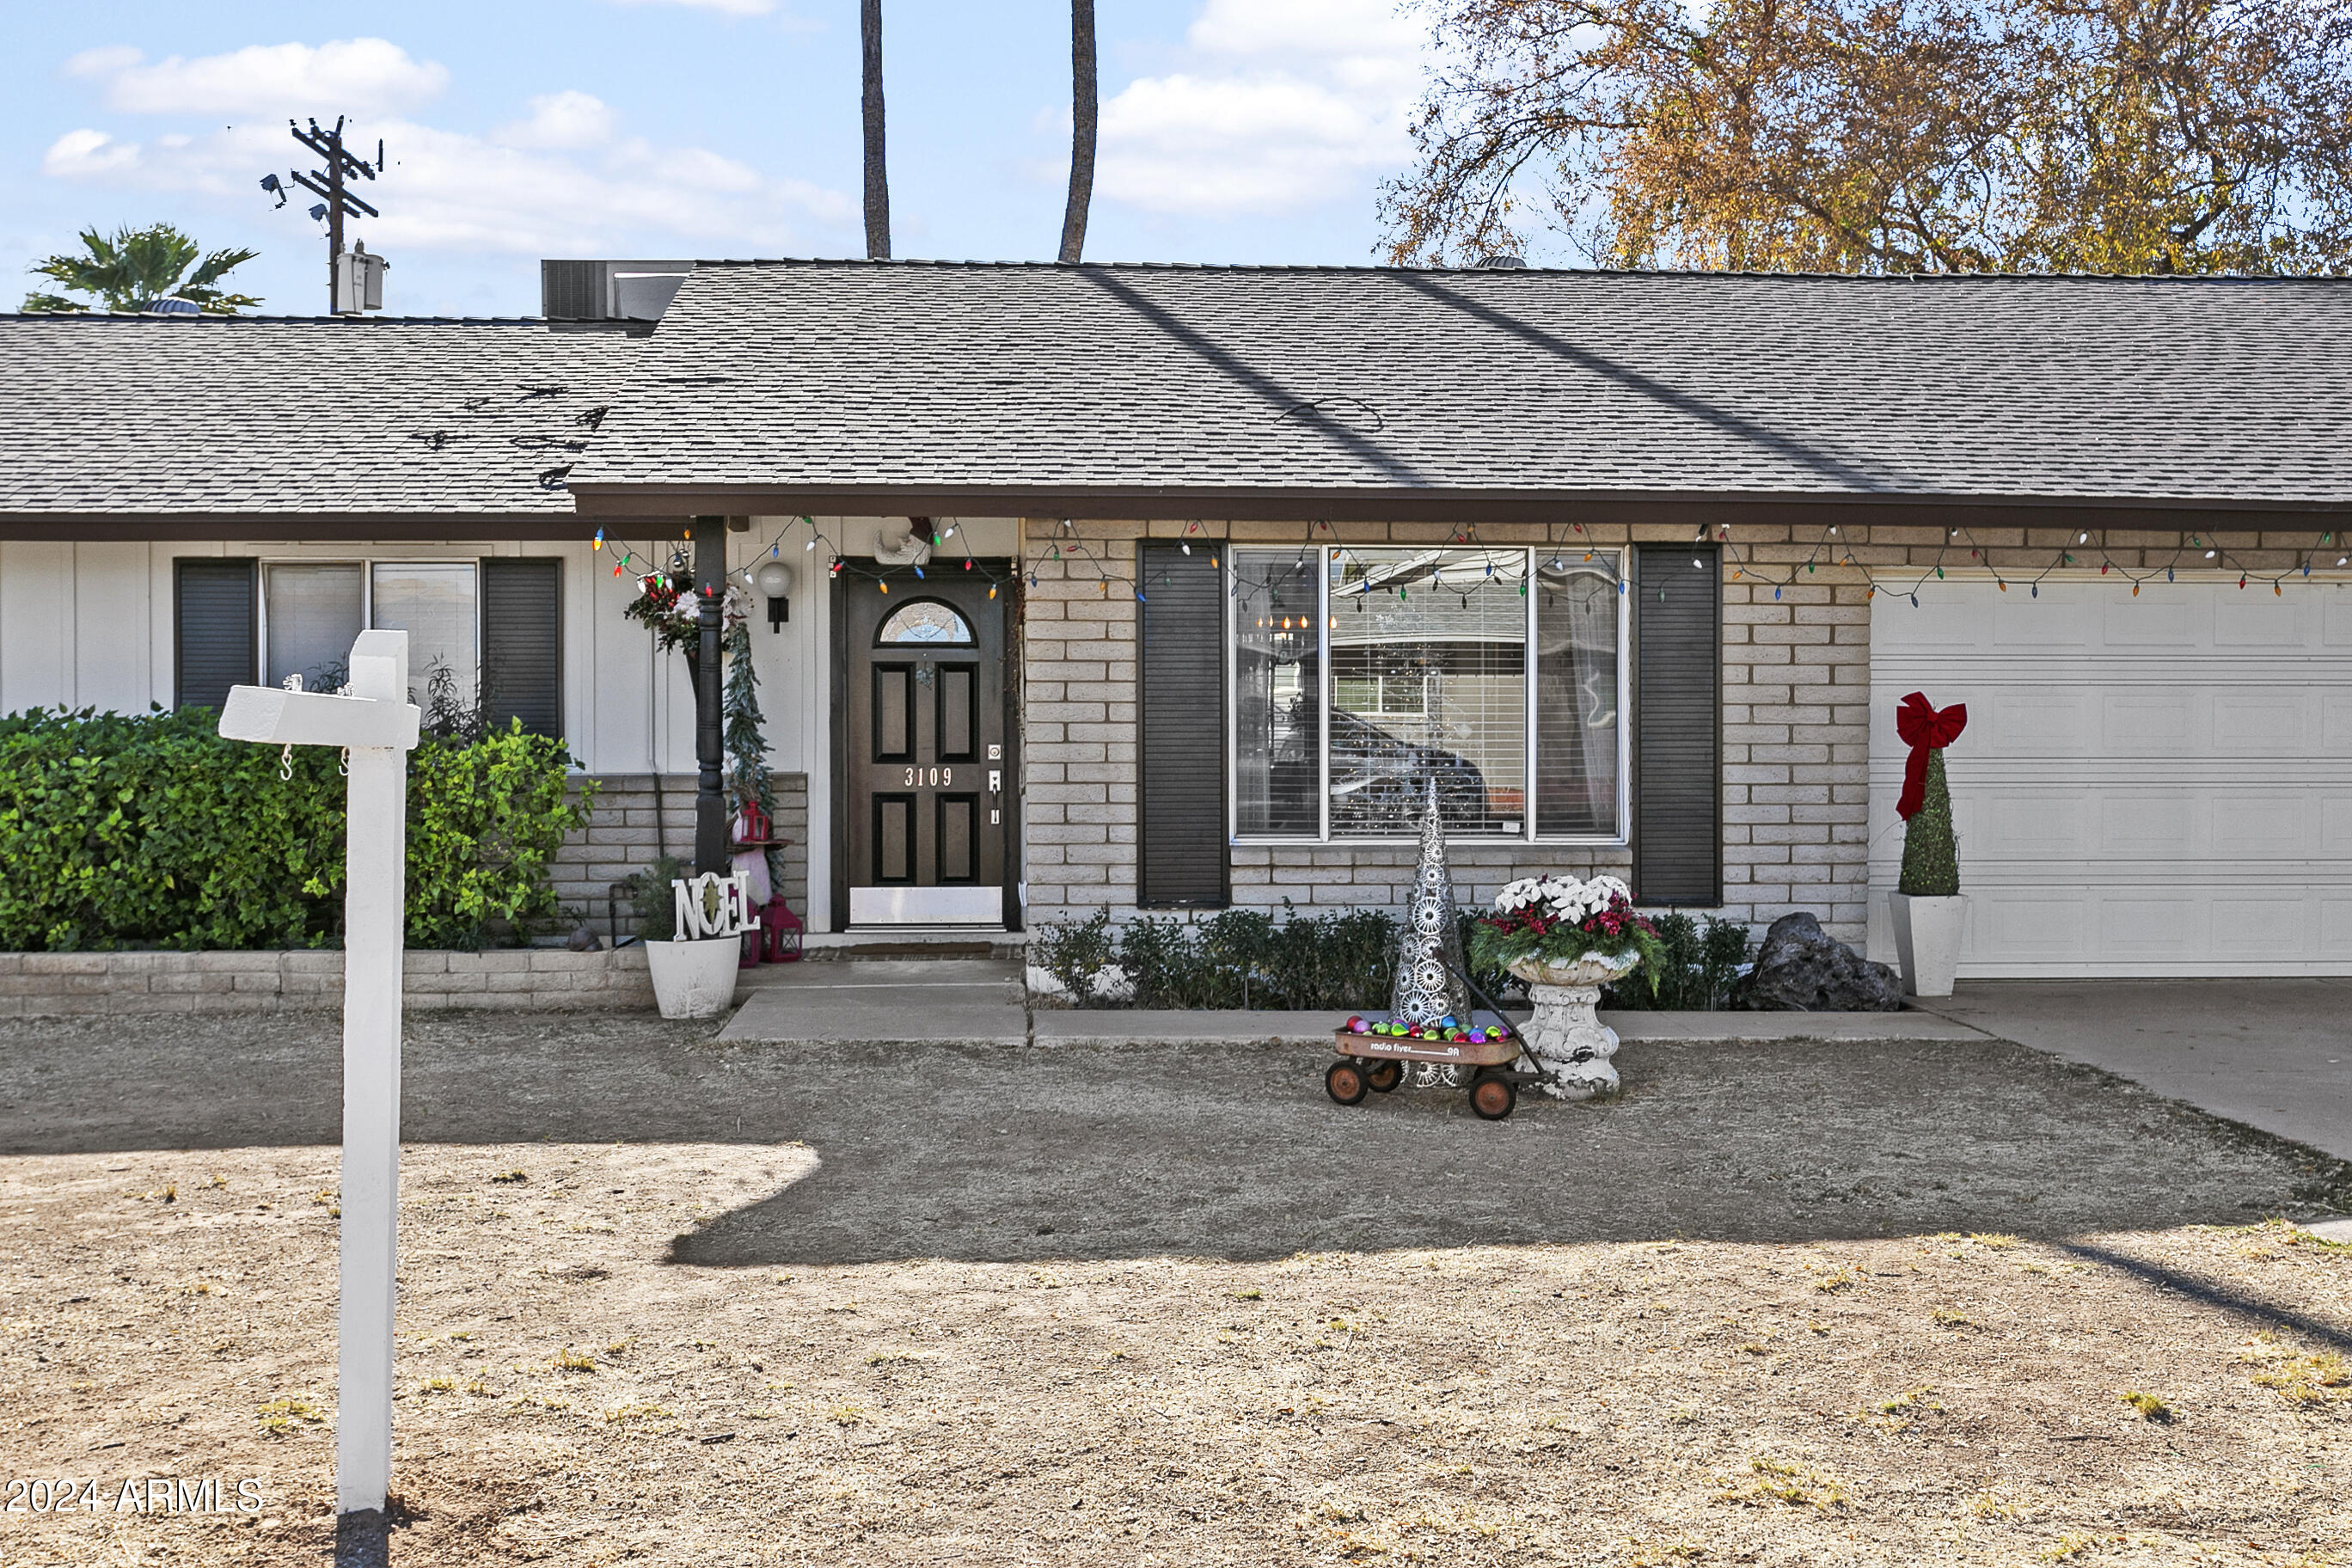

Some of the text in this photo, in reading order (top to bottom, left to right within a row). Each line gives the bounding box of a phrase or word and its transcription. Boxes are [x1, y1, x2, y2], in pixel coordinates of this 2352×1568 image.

[904, 767, 952, 787] 3109
[671, 870, 761, 943] NOEL
[1370, 1042, 1393, 1052] radio
[1393, 1043, 1412, 1053] flyer
